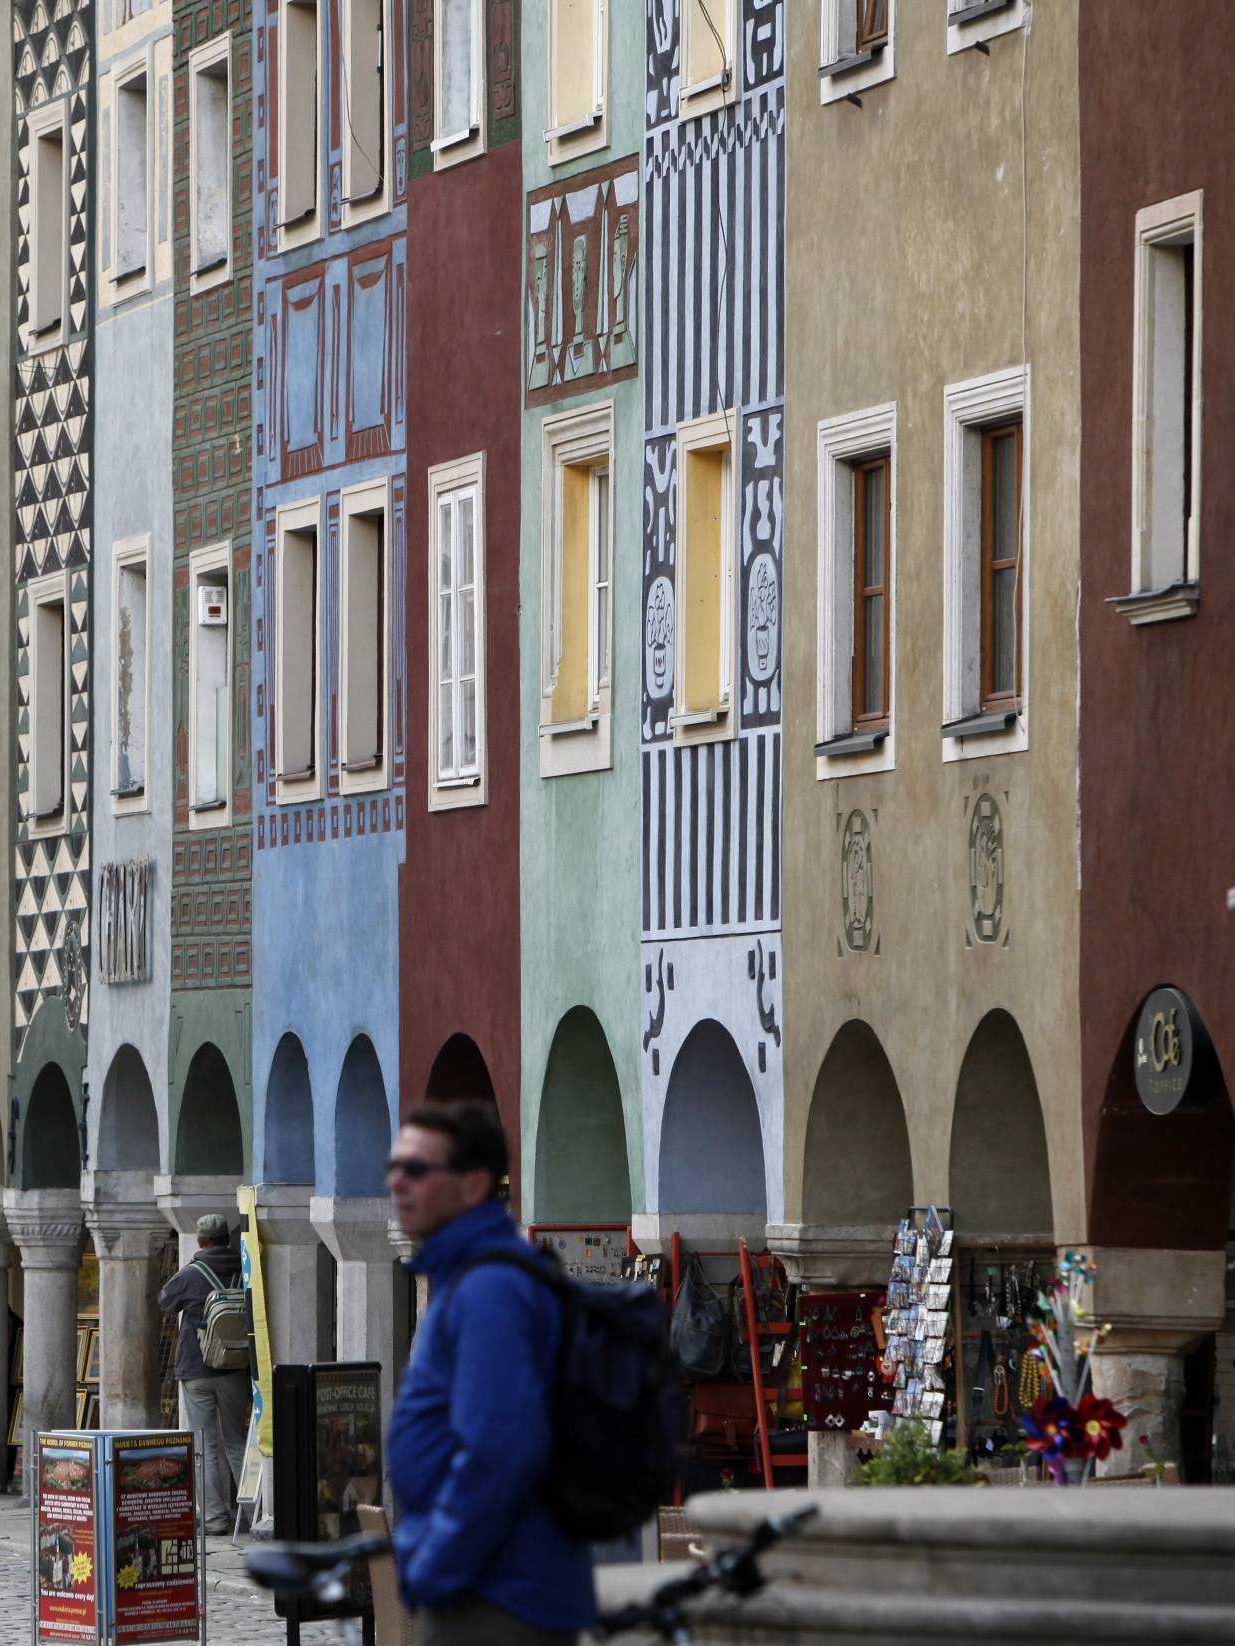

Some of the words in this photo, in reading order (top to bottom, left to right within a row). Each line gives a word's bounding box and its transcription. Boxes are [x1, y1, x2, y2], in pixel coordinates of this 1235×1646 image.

[40, 1588, 48, 1596] You
[56, 1590, 74, 1599] welcome
[75, 1592, 86, 1602] every
